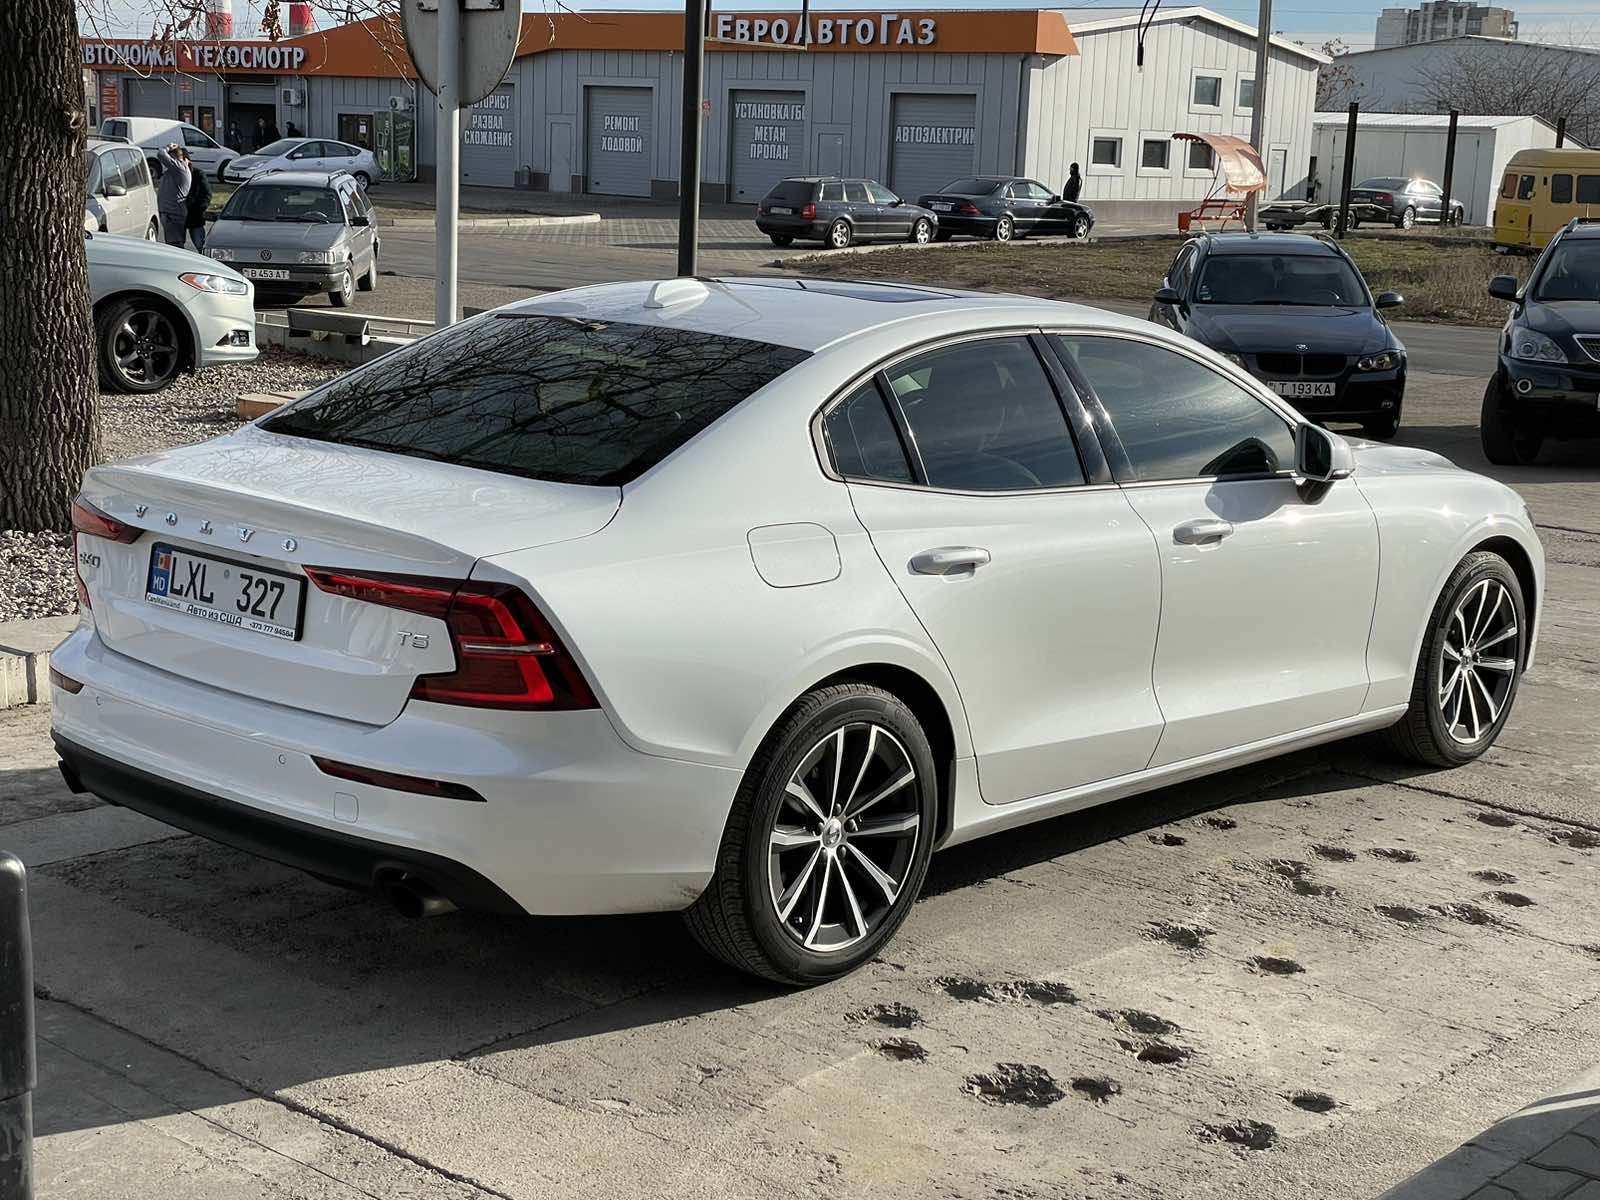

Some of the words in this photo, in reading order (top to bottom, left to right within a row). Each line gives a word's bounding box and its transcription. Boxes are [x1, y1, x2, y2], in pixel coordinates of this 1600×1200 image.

[192, 46, 305, 68] ТЕХОСМОТР
[736, 103, 789, 120] УСТАНОВКА
[472, 114, 503, 129] РАЗВАЛ
[604, 115, 640, 131] РЕМОНТ
[464, 130, 512, 146] СХОЖДЕНИЕ
[754, 126, 786, 142] МЕТАН
[601, 136, 642, 153] ХОДОВОЙ
[750, 143, 788, 160] ПРОПАН
[259, 270, 274, 278] 453
[276, 271, 286, 279] AT
[1280, 382, 1287, 394] T
[1293, 383, 1312, 395] 193
[1315, 384, 1332, 395] KA
[135, 503, 298, 553] VOLVO
[169, 557, 214, 604] LXL
[236, 573, 286, 620] 327
[186, 604, 207, 617] Авто
[208, 610, 219, 620] из
[219, 612, 243, 626] США
[263, 625, 273, 634] 777
[397, 631, 430, 649] T5
